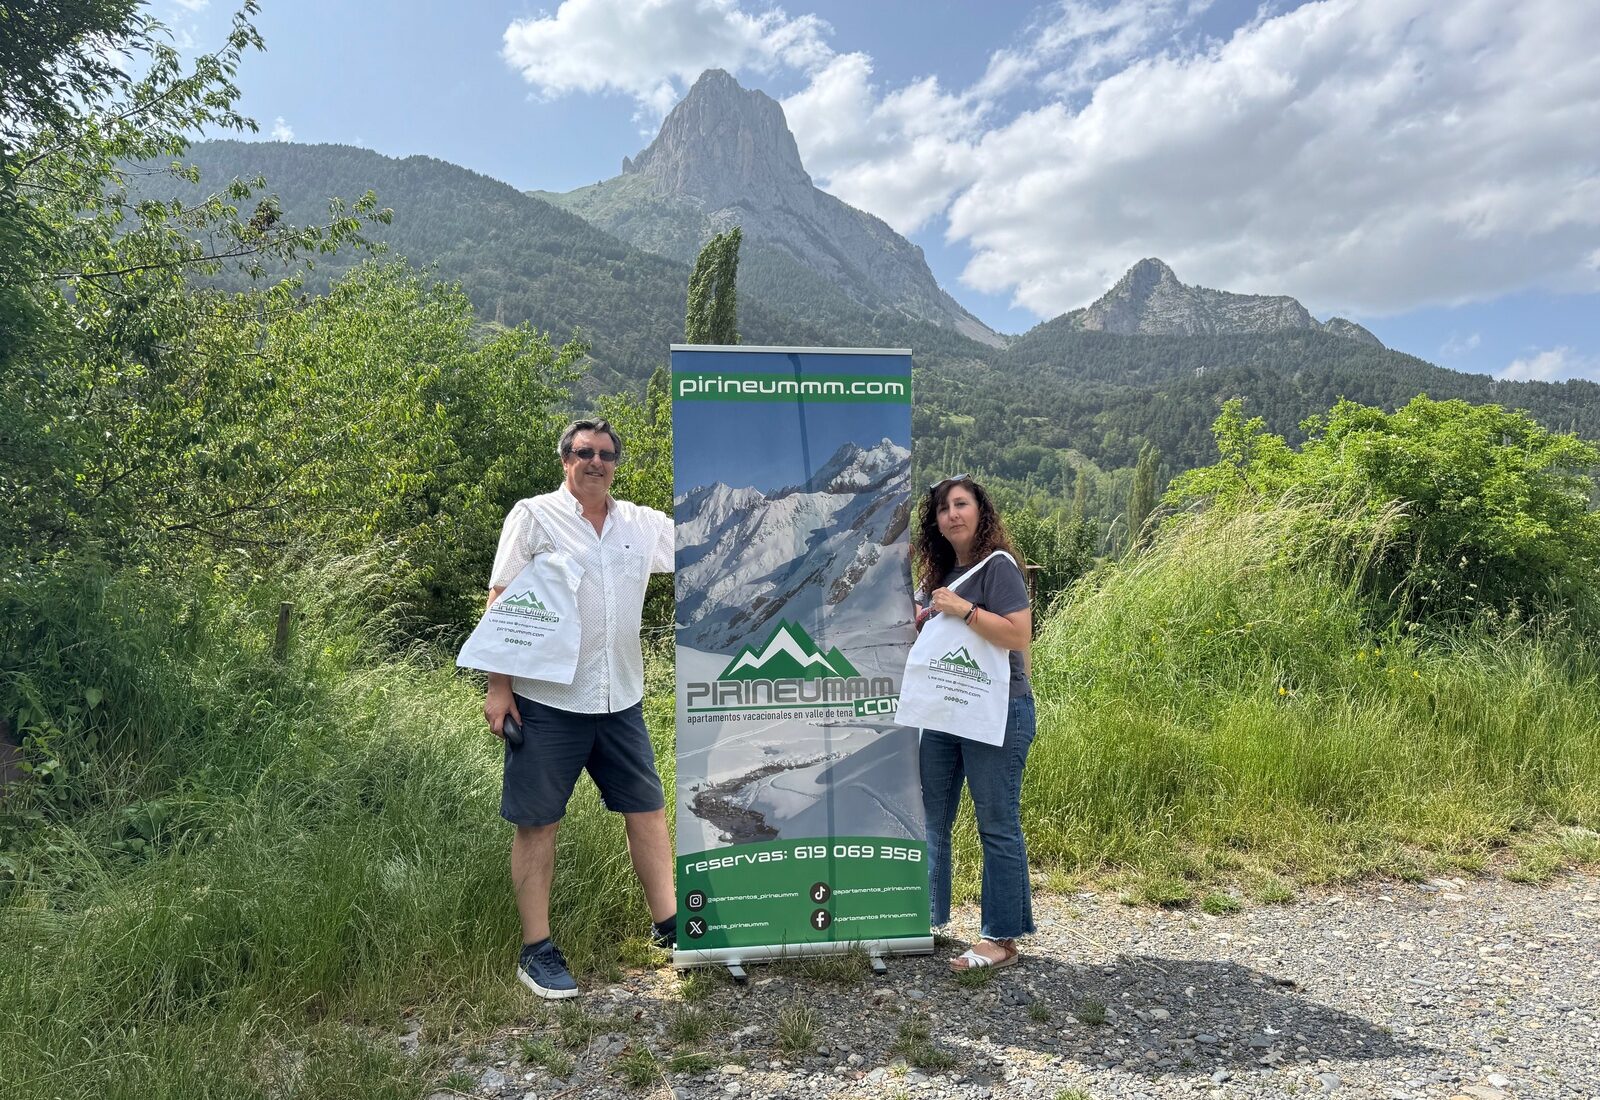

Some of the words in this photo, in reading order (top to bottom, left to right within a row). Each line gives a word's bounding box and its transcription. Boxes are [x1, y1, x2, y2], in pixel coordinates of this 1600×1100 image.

[679, 376, 904, 396] pirineummm.com
[496, 626, 545, 638] pirineummm.com
[687, 677, 894, 706] PIRINEUMMM
[687, 712, 741, 725] apartamentos
[743, 710, 792, 721] vacacionales
[794, 711, 803, 719] en
[805, 709, 824, 718] valle
[826, 708, 835, 718] de
[836, 709, 853, 718] tena
[685, 849, 788, 875] reservas:
[794, 845, 827, 860] 619
[833, 845, 874, 858] 069
[880, 846, 922, 862] 358
[833, 886, 921, 896] @apartamentos_pirineummm
[707, 892, 799, 903] @apartamentos_pirineummm
[834, 914, 879, 922] Apartamentos
[708, 921, 770, 931] @apts_pirineummm
